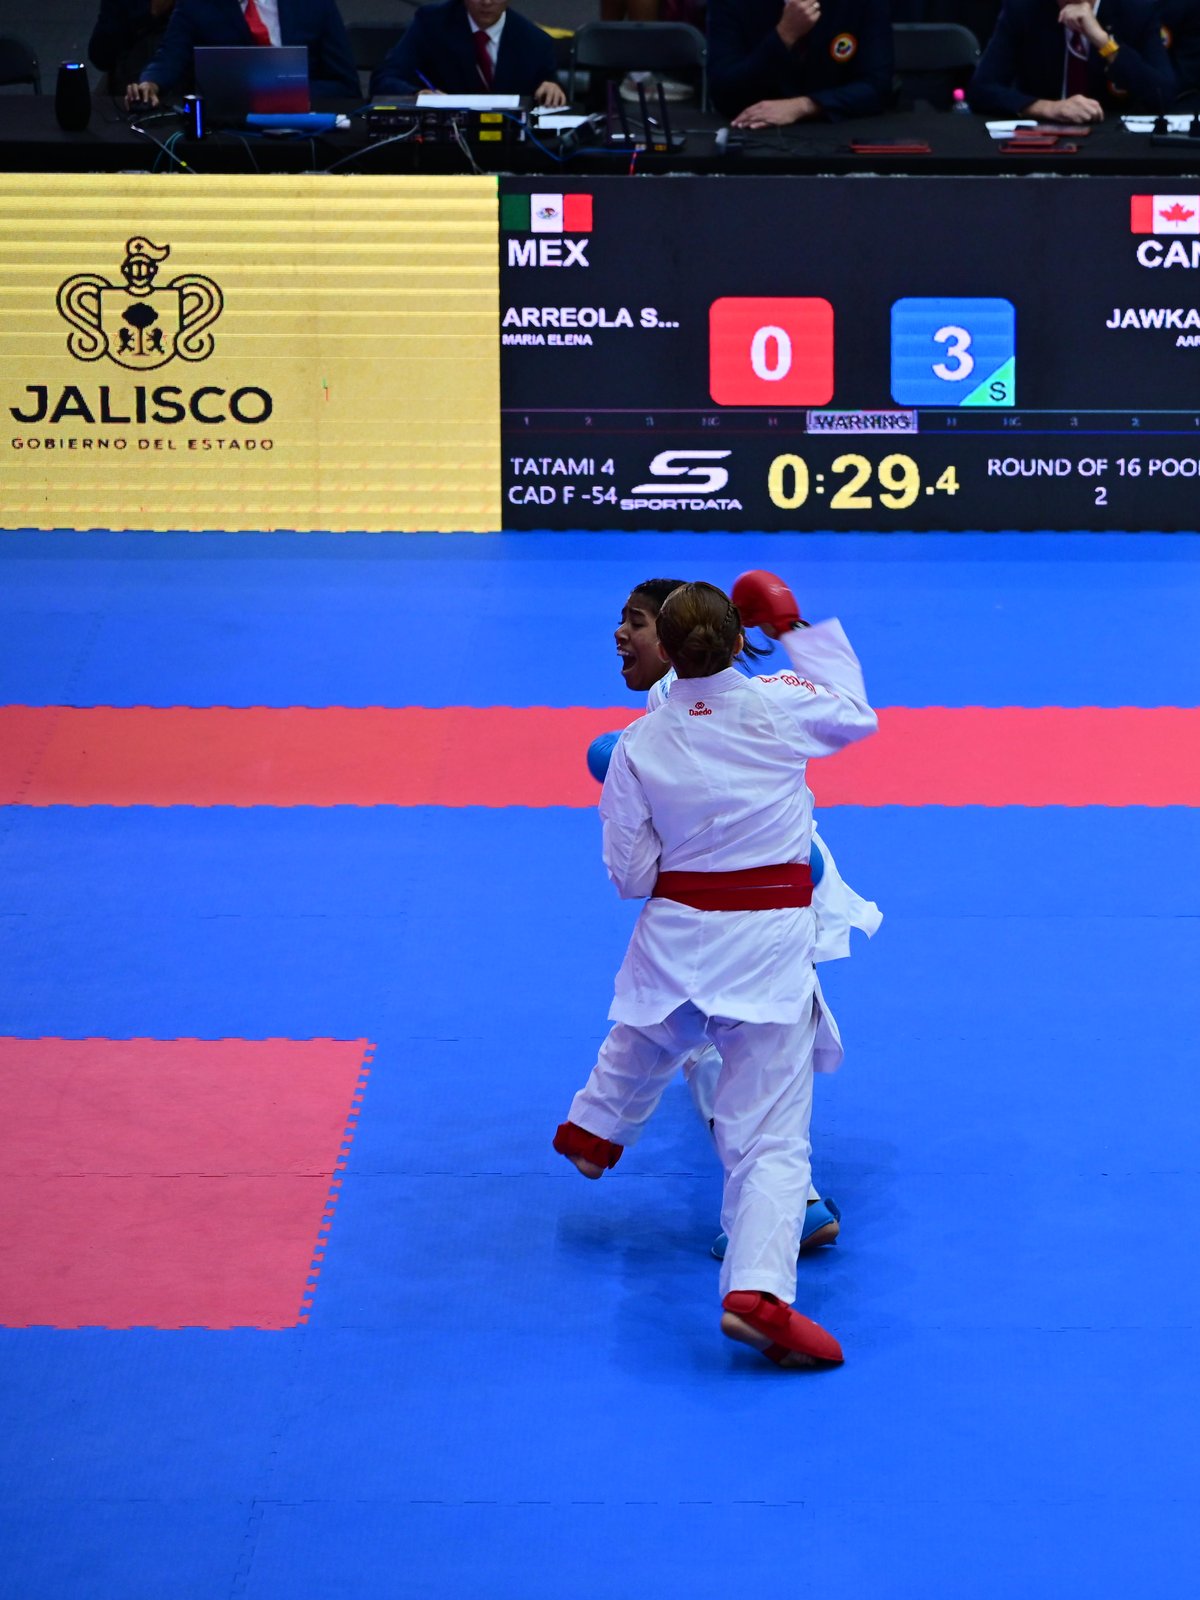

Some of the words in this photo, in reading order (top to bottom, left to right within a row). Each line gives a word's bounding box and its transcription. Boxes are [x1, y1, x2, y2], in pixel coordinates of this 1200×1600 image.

[508, 238, 589, 267] MEX
[502, 307, 634, 328] ARREOLA
[639, 307, 679, 328] S...
[502, 334, 545, 346] MARIA
[547, 334, 593, 346] ELENA
[750, 325, 792, 382] 0
[932, 326, 974, 381] 3
[989, 381, 1006, 402] S
[9, 385, 273, 424] JALISCO
[813, 414, 912, 430] WARNING
[11, 438, 127, 450] GOBIERNO
[138, 438, 176, 450] DEL
[188, 438, 274, 450] ESTADO
[510, 458, 594, 475] TATAMI
[600, 458, 614, 475] 4
[987, 457, 1072, 476] ROUND
[1077, 457, 1108, 476] OF
[1116, 457, 1141, 476] 16
[508, 486, 556, 504] CAD
[563, 486, 575, 504] F
[581, 486, 617, 504] -54
[620, 498, 743, 510] SPORTDATA
[1094, 486, 1108, 505] 2
[688, 707, 712, 716] Daedo
